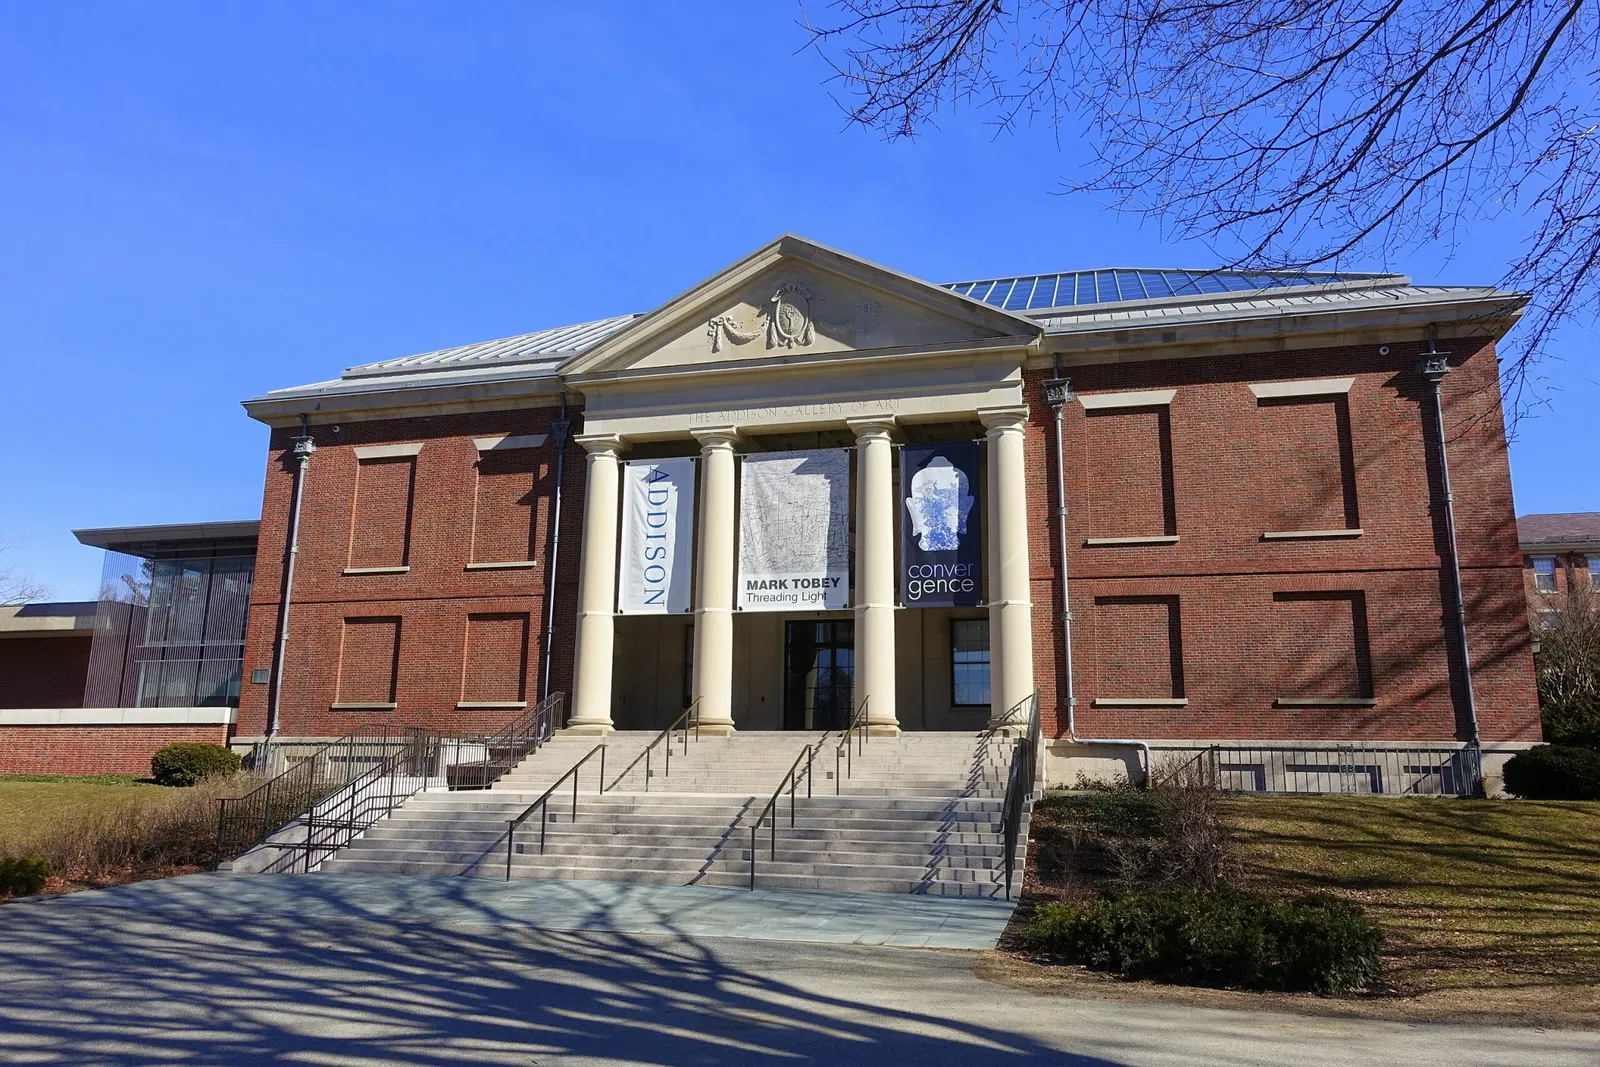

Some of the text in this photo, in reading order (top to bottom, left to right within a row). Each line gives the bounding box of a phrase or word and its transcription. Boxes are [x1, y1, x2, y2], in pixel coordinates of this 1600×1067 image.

[689, 411, 710, 424] THE
[718, 406, 777, 423] ADDISON
[783, 402, 845, 417] GALLERY
[851, 401, 868, 413] OF
[875, 399, 900, 412] ART
[643, 466, 670, 607] ADDISON
[908, 563, 974, 578] conver
[746, 577, 841, 590] MARK TOBEY
[908, 578, 974, 600] gence
[746, 591, 827, 604] Threading Light
